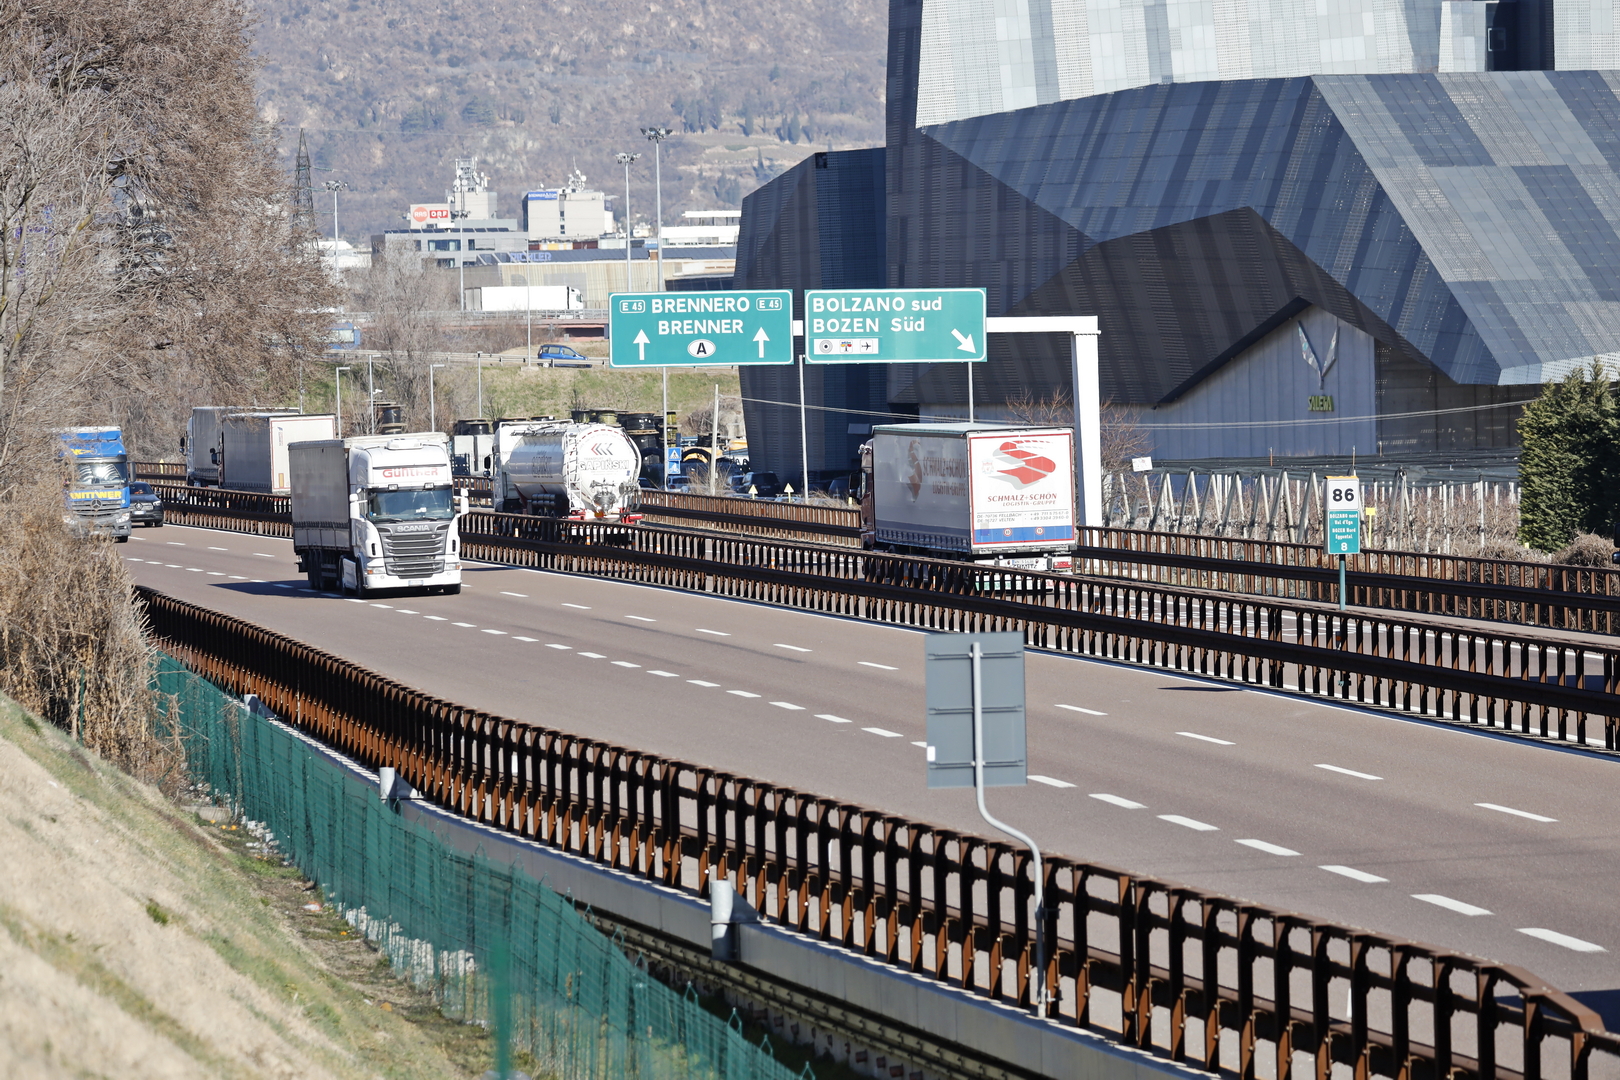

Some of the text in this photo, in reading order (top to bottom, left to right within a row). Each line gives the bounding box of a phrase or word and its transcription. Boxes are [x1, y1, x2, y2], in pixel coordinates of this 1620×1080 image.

[622, 297, 779, 313] E 45 BRENNERO E 45
[812, 296, 942, 312] BOLZANO sud
[658, 319, 744, 335] BRENNER
[813, 316, 925, 333] BOZEN Süd
[696, 342, 707, 355] A
[1332, 488, 1355, 502] 86
[397, 524, 430, 533] SCANIA
[1341, 542, 1348, 552] 8
